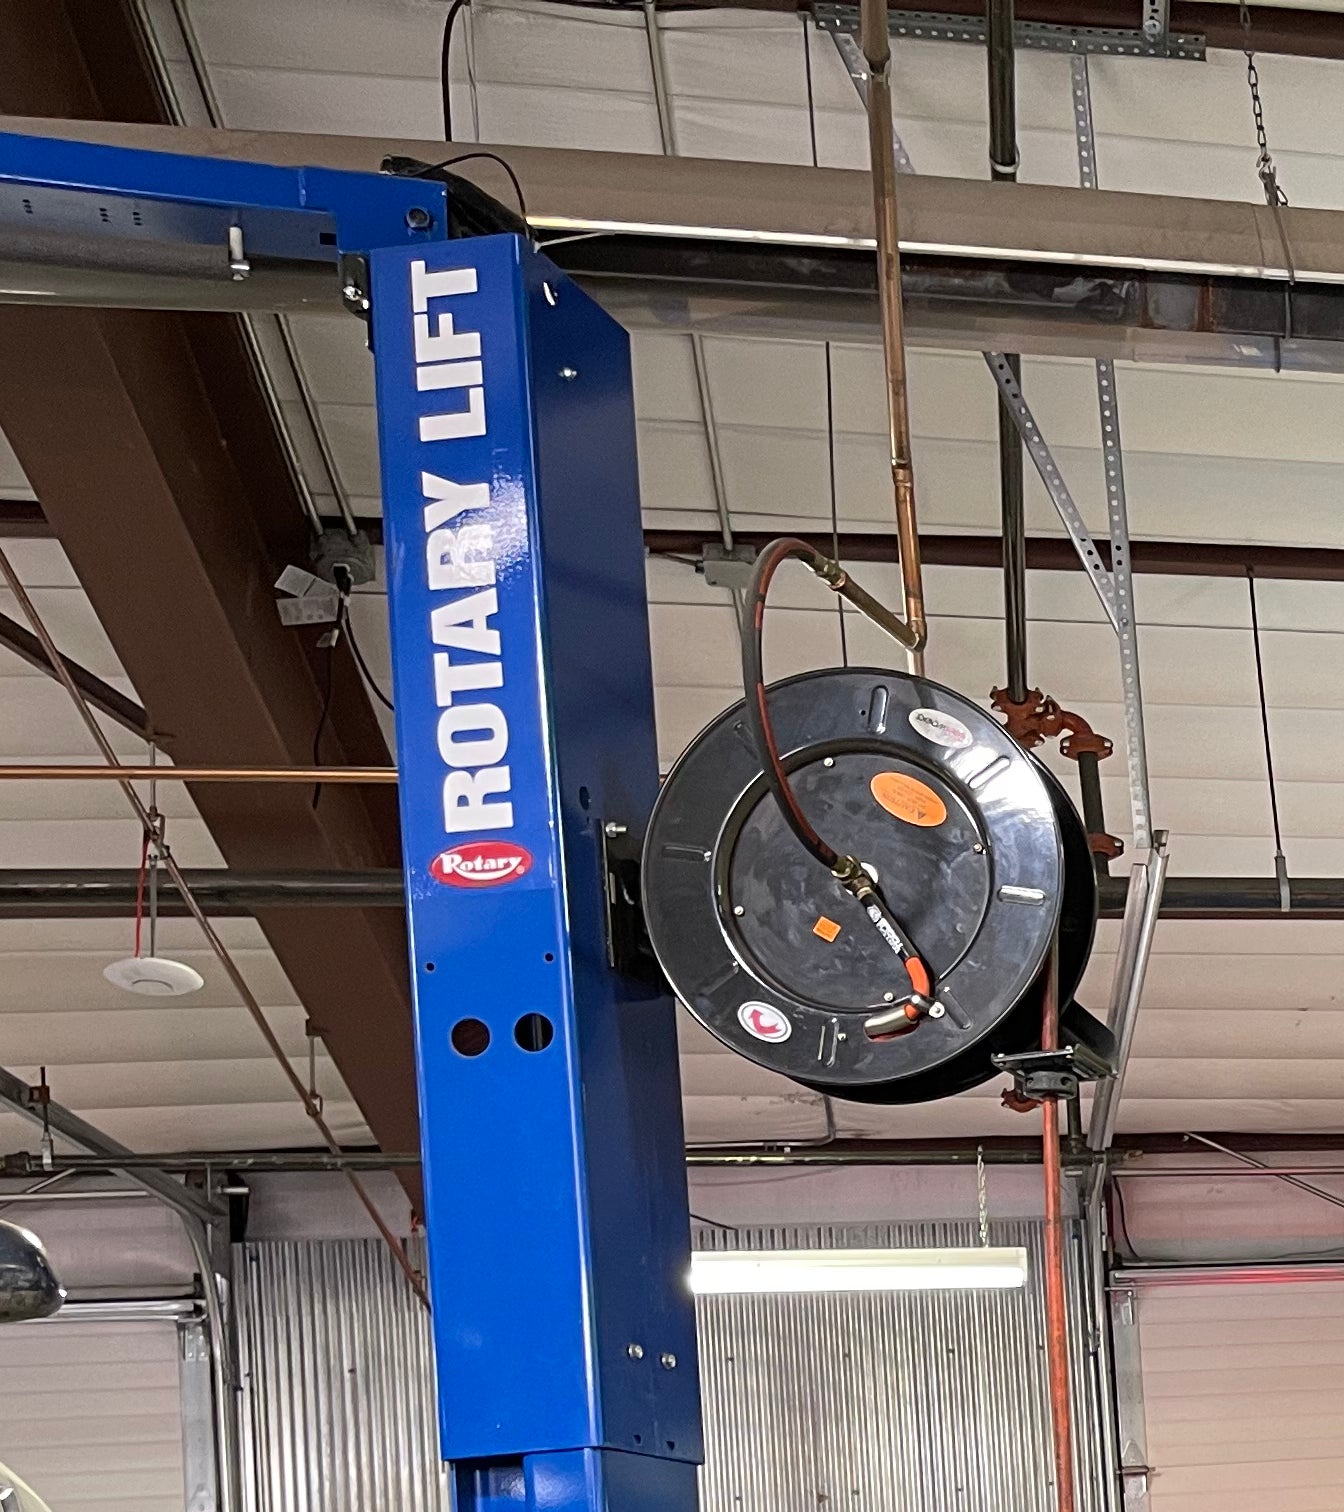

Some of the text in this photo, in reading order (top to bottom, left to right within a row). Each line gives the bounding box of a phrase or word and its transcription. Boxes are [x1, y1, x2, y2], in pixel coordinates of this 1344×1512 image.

[410, 258, 514, 834] ROTARY LIFT
[440, 852, 523, 881] Rotary
